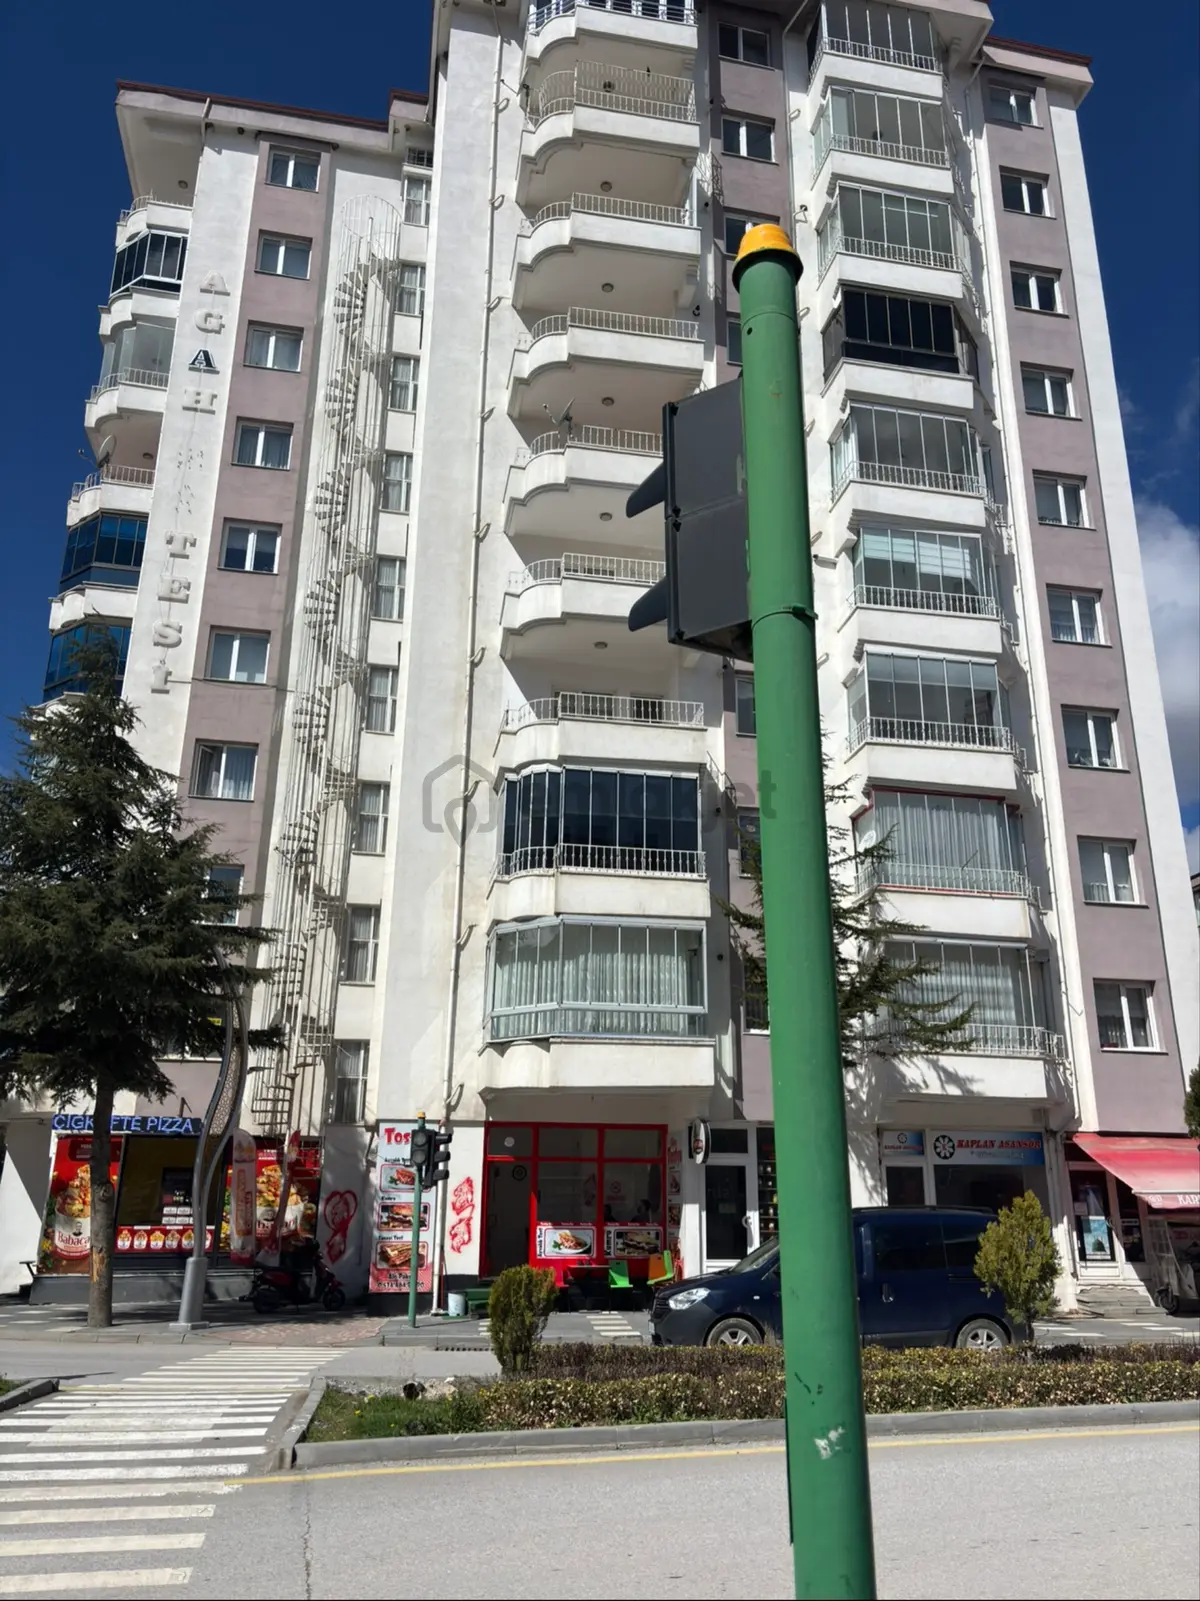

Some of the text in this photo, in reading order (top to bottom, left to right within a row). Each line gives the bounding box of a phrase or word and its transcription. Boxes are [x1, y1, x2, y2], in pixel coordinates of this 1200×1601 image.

[147, 1116, 194, 1132] PIZZA
[956, 1139, 995, 1149] KAPLAN
[1177, 1194, 1200, 1205] KAR
[57, 1231, 91, 1246] Babaca
